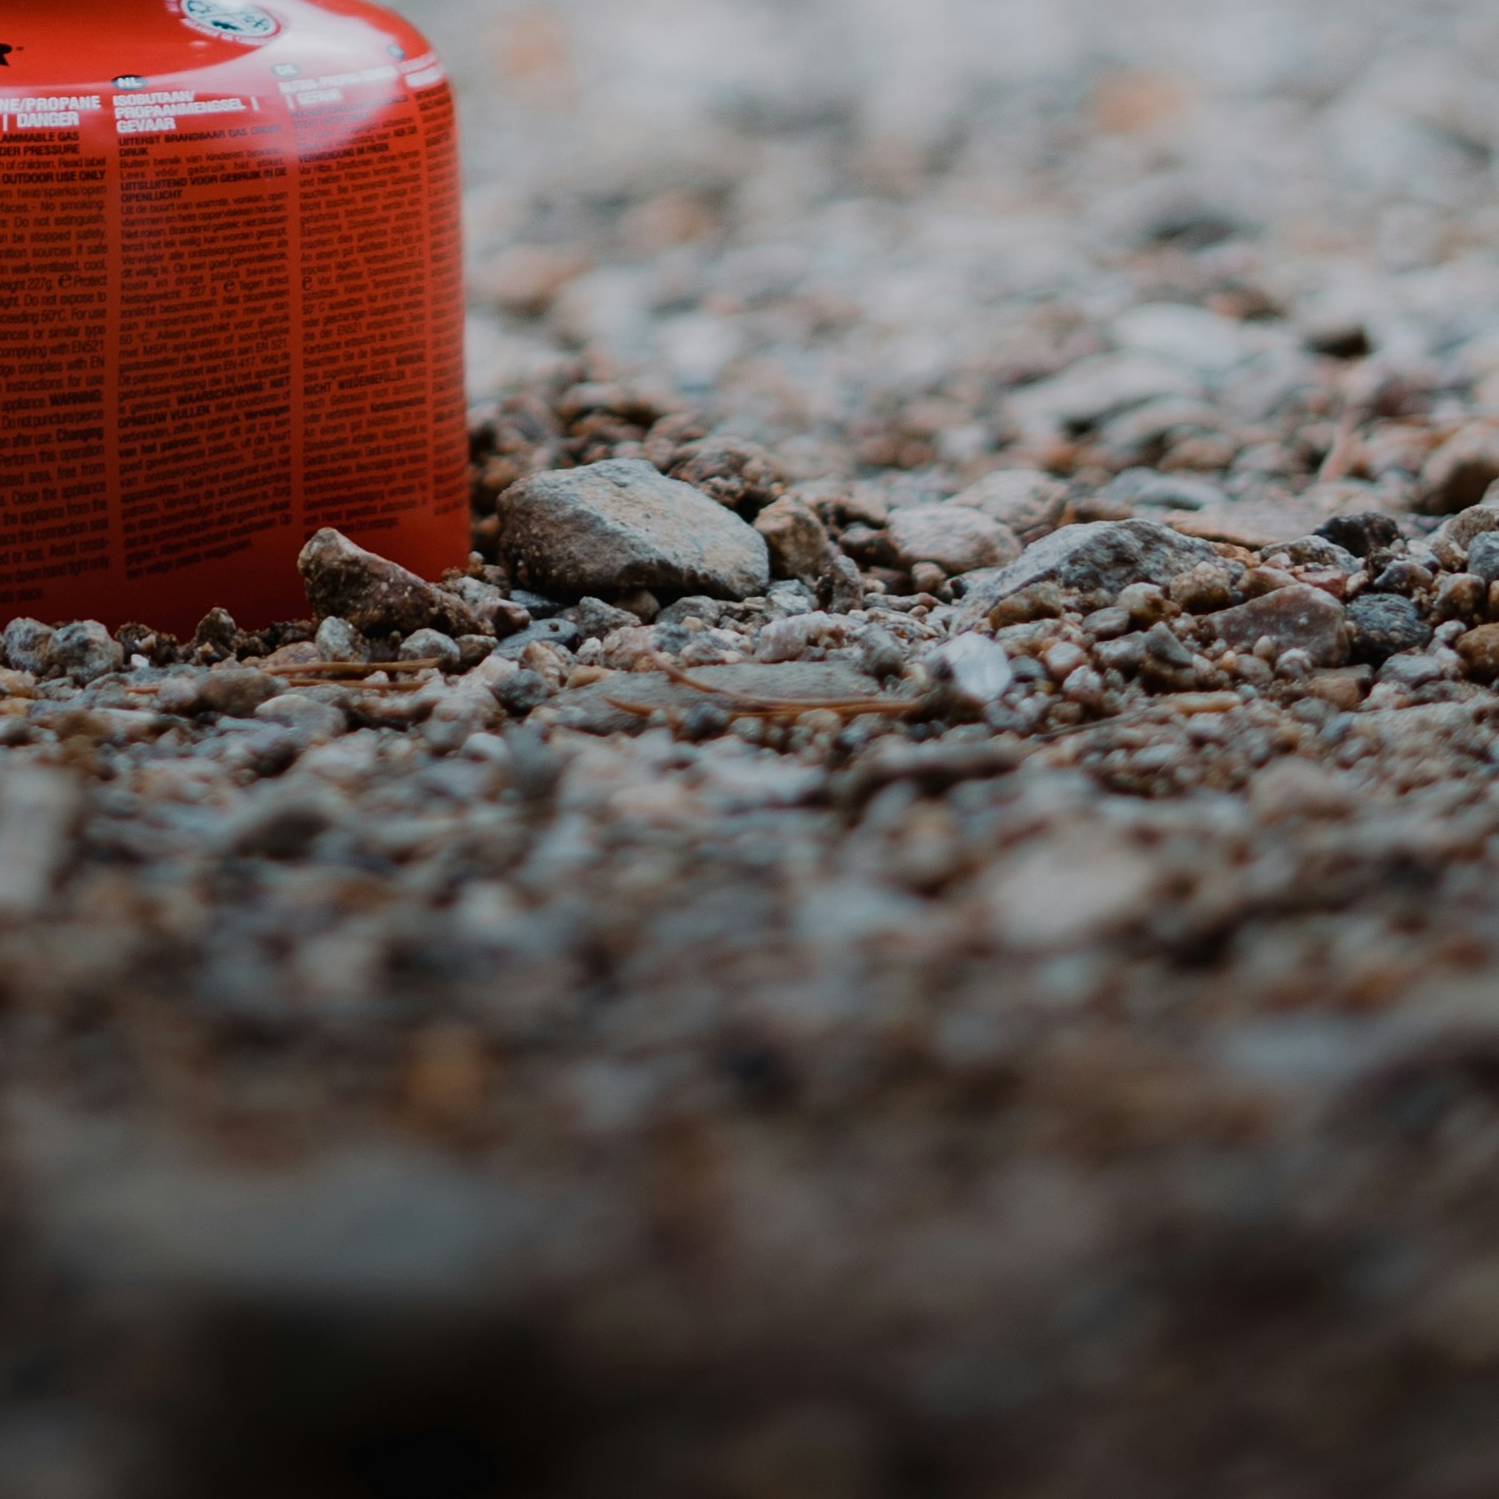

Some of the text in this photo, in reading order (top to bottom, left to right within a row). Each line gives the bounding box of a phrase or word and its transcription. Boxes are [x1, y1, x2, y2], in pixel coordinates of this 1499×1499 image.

[118, 77, 141, 87] NL
[17, 111, 79, 128] DANGER
[117, 118, 176, 134] GEVAAR
[58, 132, 79, 141] GAS
[23, 144, 79, 155] PRESSURE
[2, 173, 53, 184] OUTDOOR
[56, 171, 76, 181] USE
[79, 170, 105, 180] ONLY
